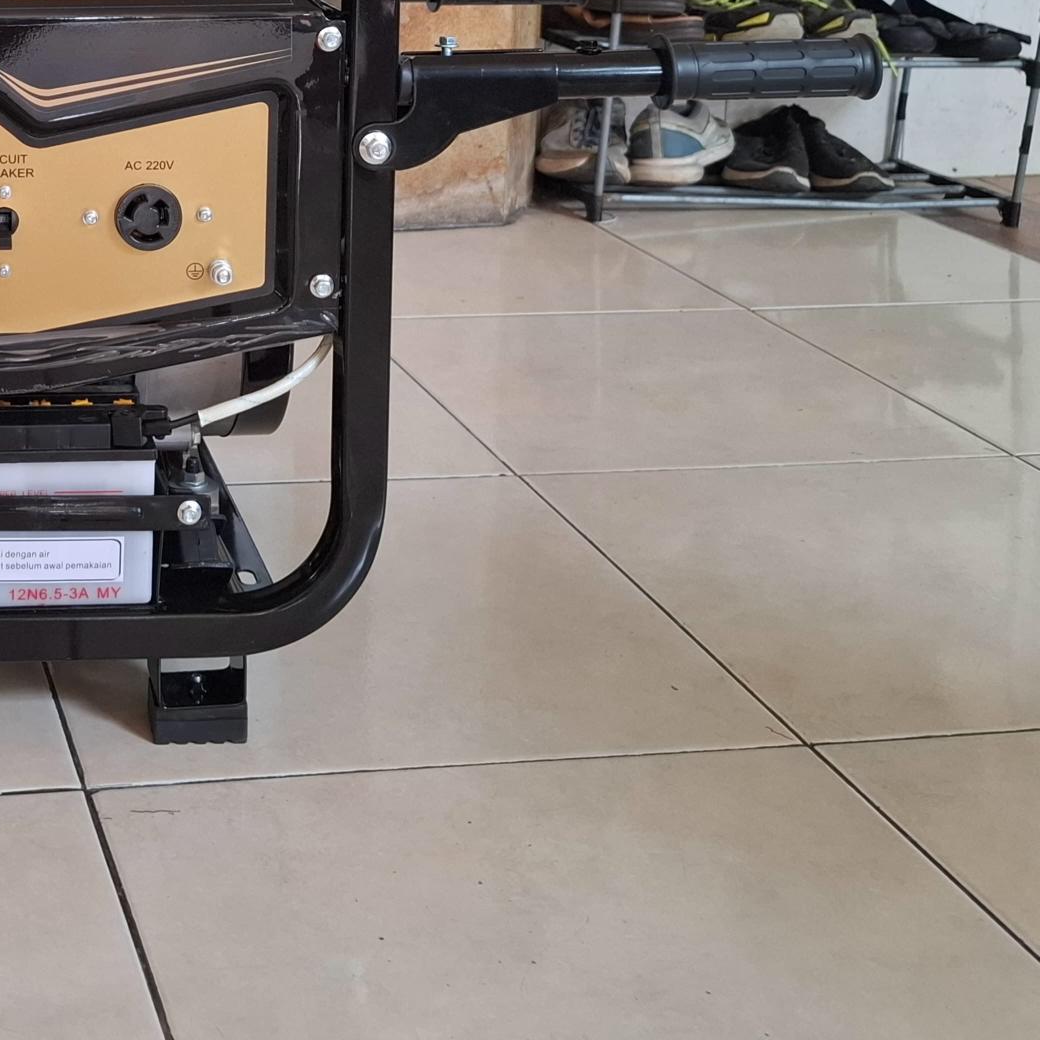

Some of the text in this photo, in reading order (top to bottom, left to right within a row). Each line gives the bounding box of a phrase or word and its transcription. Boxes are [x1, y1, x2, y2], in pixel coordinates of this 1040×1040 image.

[124, 160, 175, 171] AC 220V
[4, 551, 38, 560] dengan
[5, 562, 41, 570] sebelum
[65, 561, 112, 571] pemakaian
[9, 586, 122, 601] 12N6.5-3A MY
